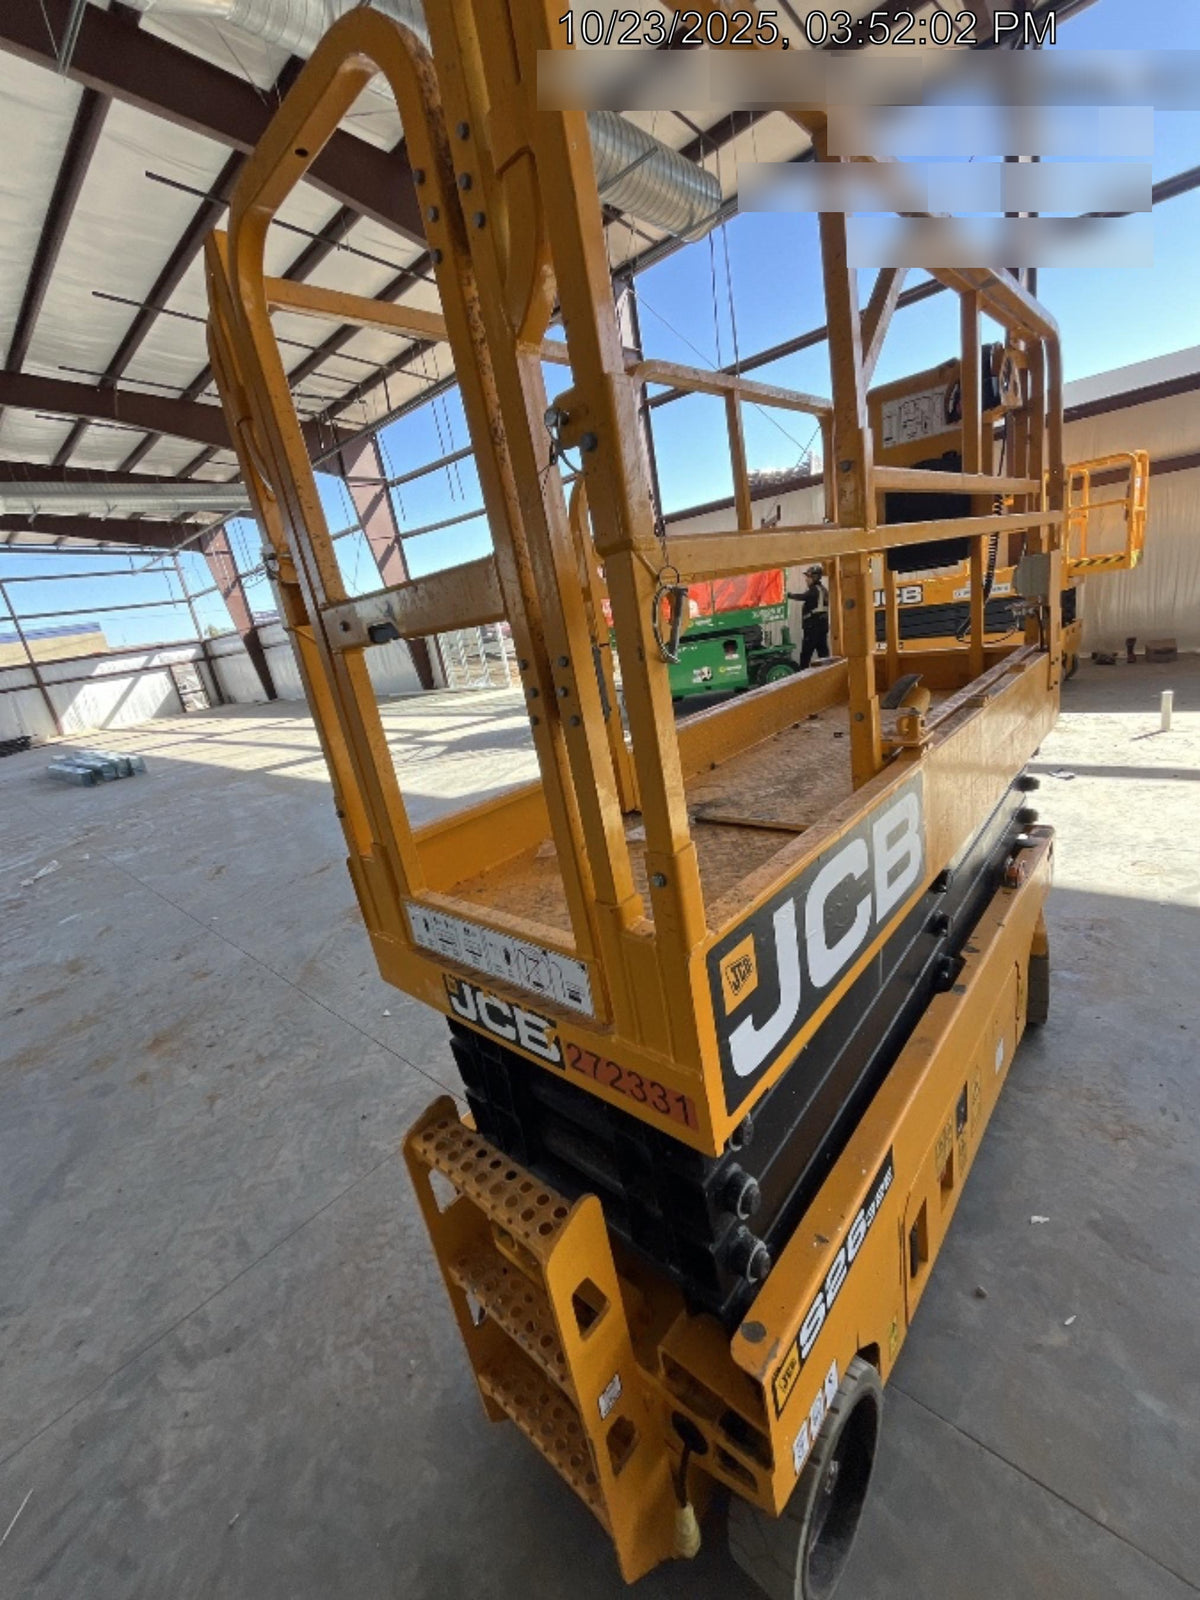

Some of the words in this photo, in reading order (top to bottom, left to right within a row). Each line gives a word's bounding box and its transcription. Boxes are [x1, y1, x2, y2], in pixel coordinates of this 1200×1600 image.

[728, 792, 923, 1077] JCB
[730, 953, 754, 990] JCB
[449, 981, 562, 1064] JCB
[565, 1042, 694, 1127] 272331
